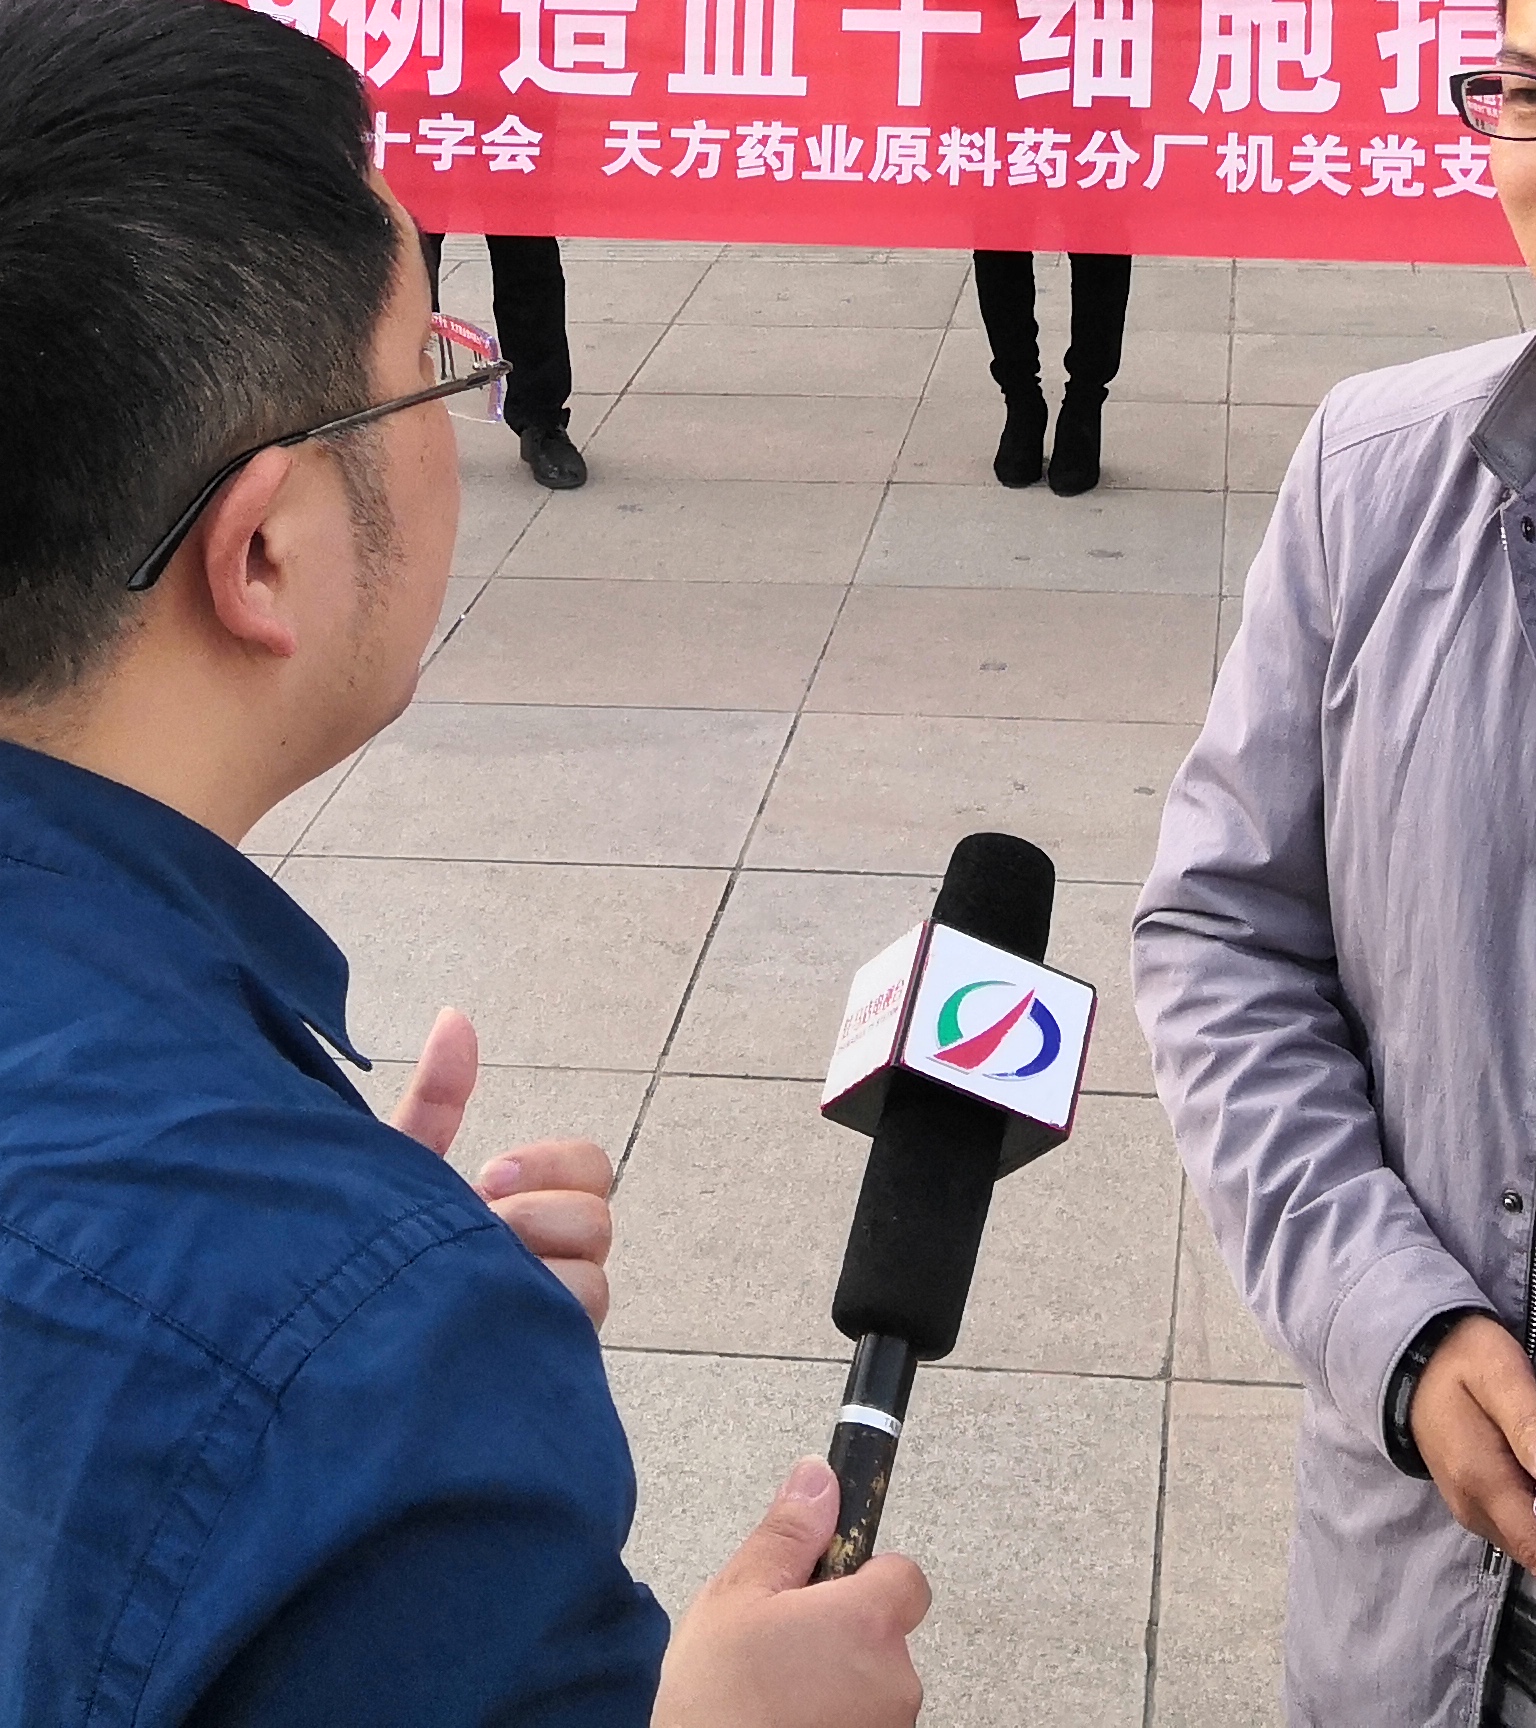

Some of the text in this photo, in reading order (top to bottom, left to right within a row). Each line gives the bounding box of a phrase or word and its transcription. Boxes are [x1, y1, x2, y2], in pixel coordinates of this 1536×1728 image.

[602, 117, 1498, 200] 天方药业原料药分厂机关党支
